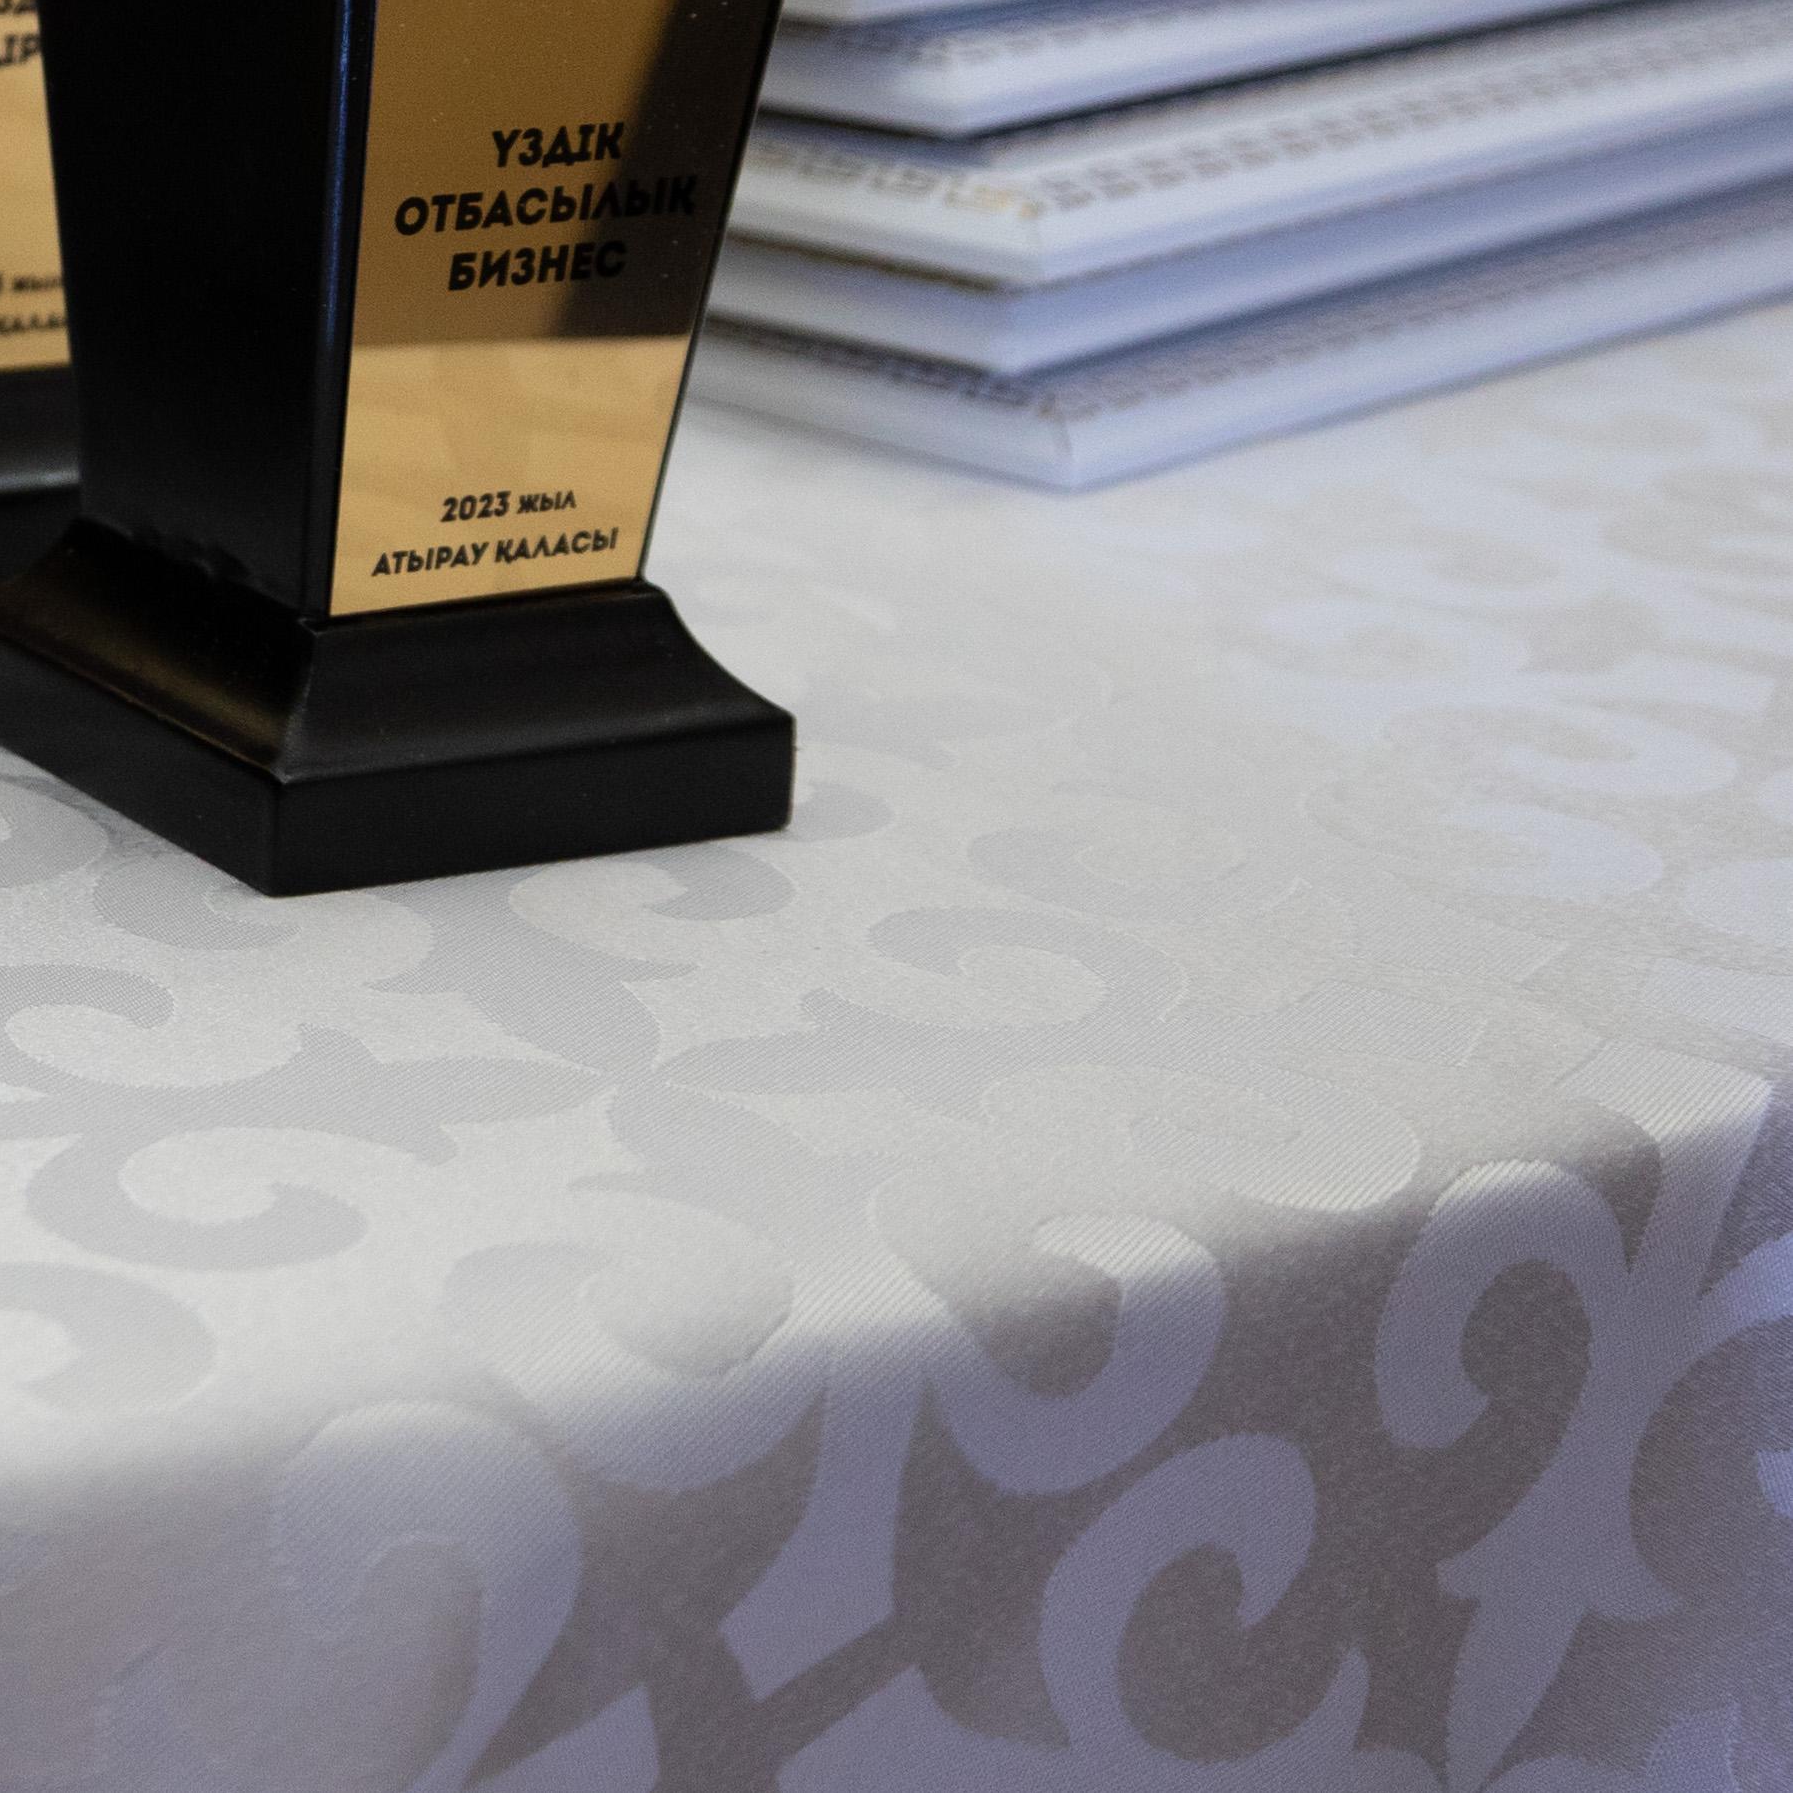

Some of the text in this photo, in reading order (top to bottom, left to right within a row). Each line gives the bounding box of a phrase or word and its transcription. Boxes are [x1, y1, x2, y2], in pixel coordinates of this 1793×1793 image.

[491, 121, 625, 168] ҮЗДІК
[448, 241, 627, 291] БИЗНЕС
[440, 491, 511, 523] 2023
[372, 528, 618, 577] АТЫРАУ ҚАЛАСЫ
